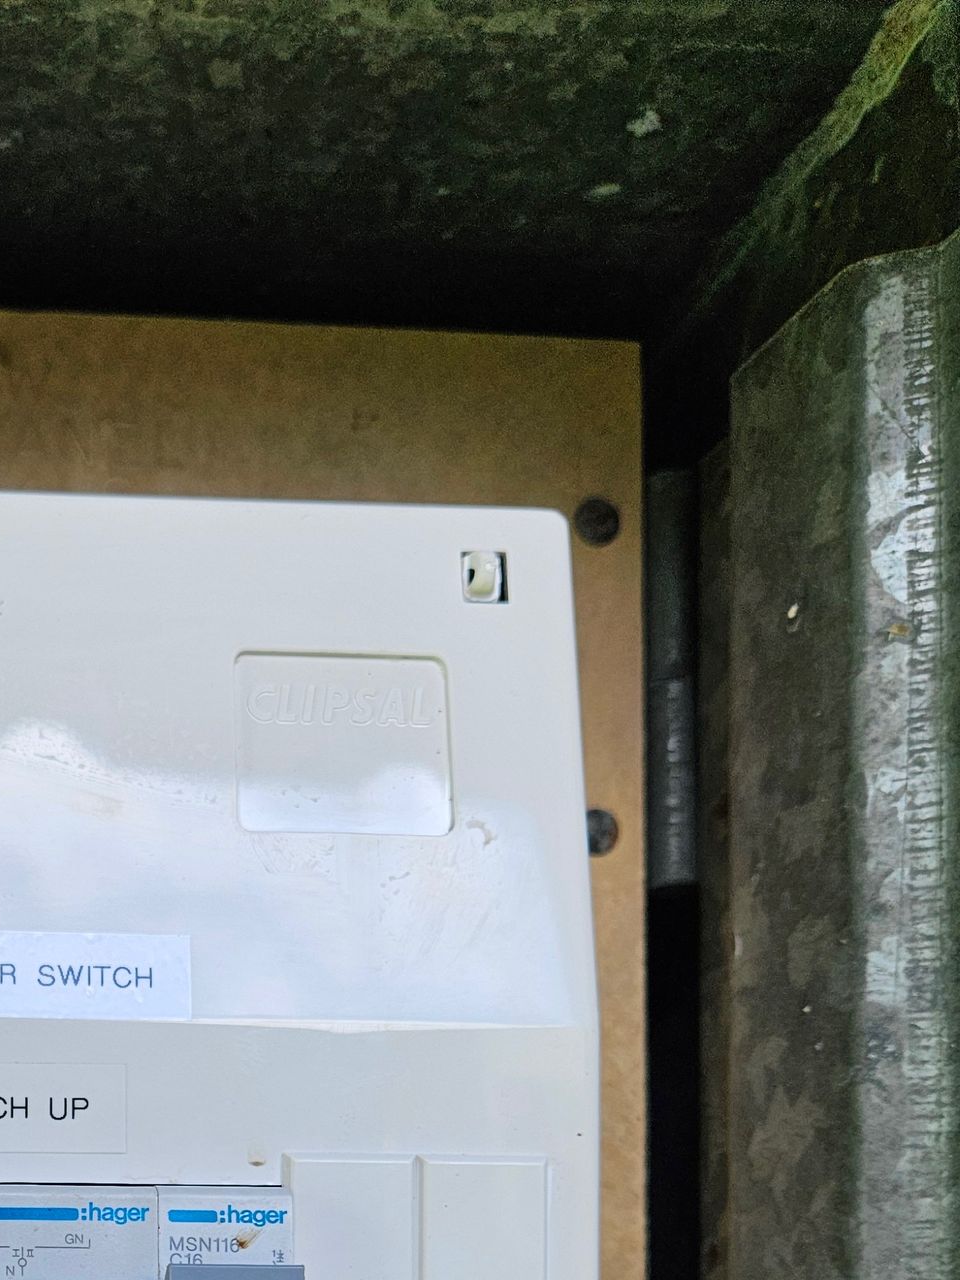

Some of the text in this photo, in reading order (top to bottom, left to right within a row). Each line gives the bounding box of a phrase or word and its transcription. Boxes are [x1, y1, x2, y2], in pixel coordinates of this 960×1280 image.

[246, 685, 434, 728] CLIPSAL
[37, 964, 153, 989] SWITCH
[49, 1097, 89, 1121] UP
[64, 1234, 85, 1246] GN
[168, 1235, 242, 1253] MSN116
[5, 1265, 16, 1277] N
